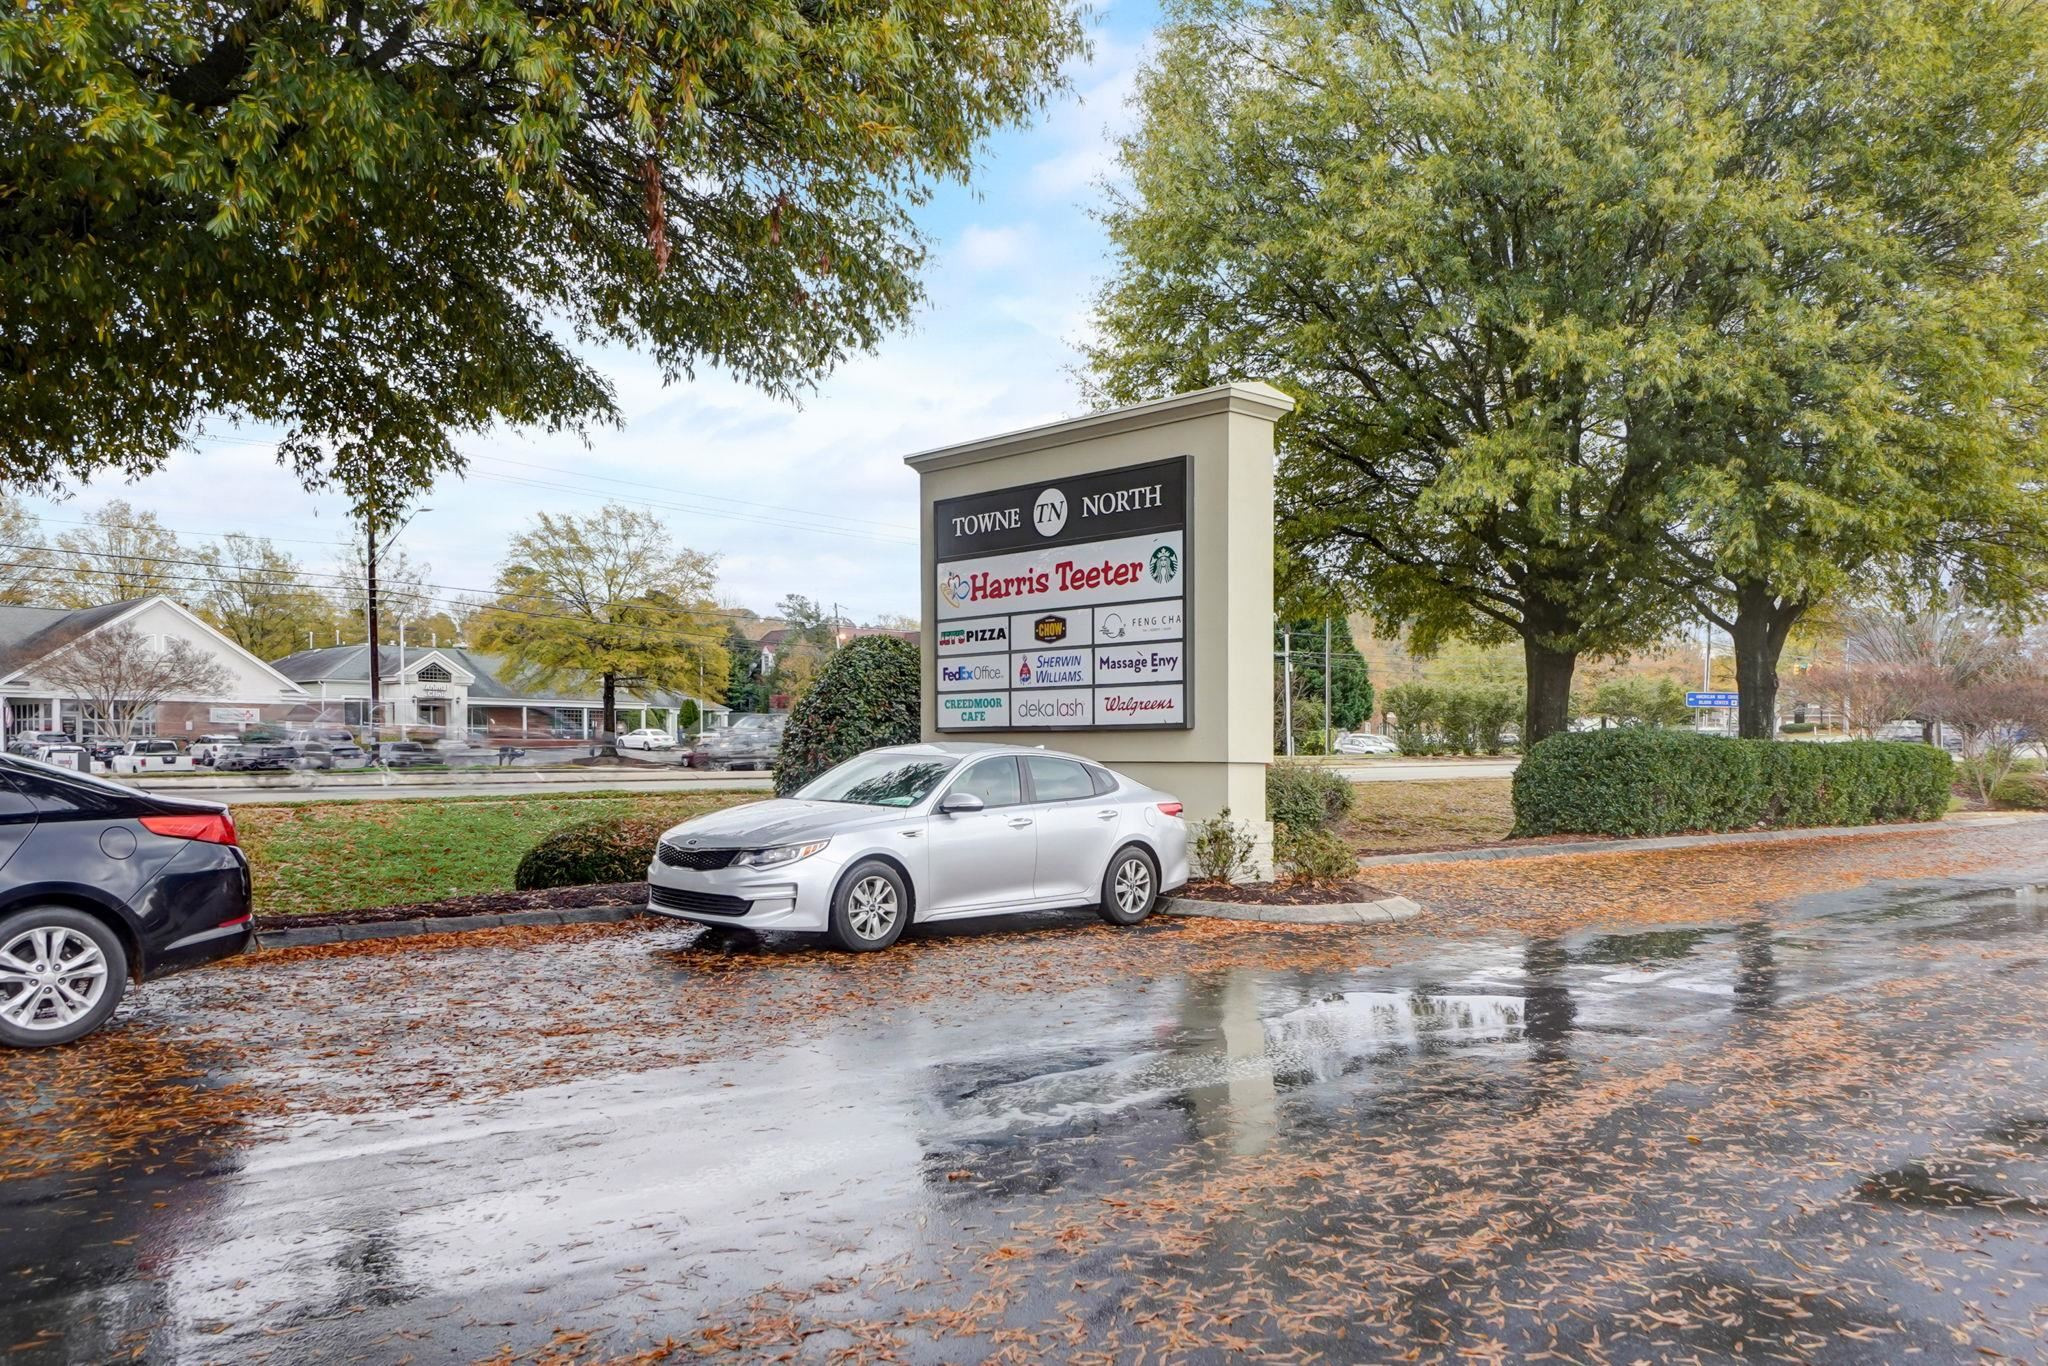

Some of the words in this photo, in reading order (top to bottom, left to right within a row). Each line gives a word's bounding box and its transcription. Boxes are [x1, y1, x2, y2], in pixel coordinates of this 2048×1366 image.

[952, 508, 1021, 536] TOWNE
[1036, 500, 1065, 524] TN
[1081, 484, 1162, 517] NORTH
[969, 567, 1049, 602] Harris
[1055, 559, 1143, 592] Teeter
[1132, 616, 1157, 626] FENG
[1161, 614, 1182, 625] CHA
[966, 627, 1007, 642] PIZZA
[1038, 622, 1063, 637] CHOW
[1036, 655, 1082, 668] SHERWIN
[1099, 656, 1147, 673] Massage
[1151, 652, 1178, 672] Envy
[944, 698, 1002, 710] CREEDMOOR
[1104, 696, 1174, 716] Walgreens
[960, 711, 986, 722] CAFE
